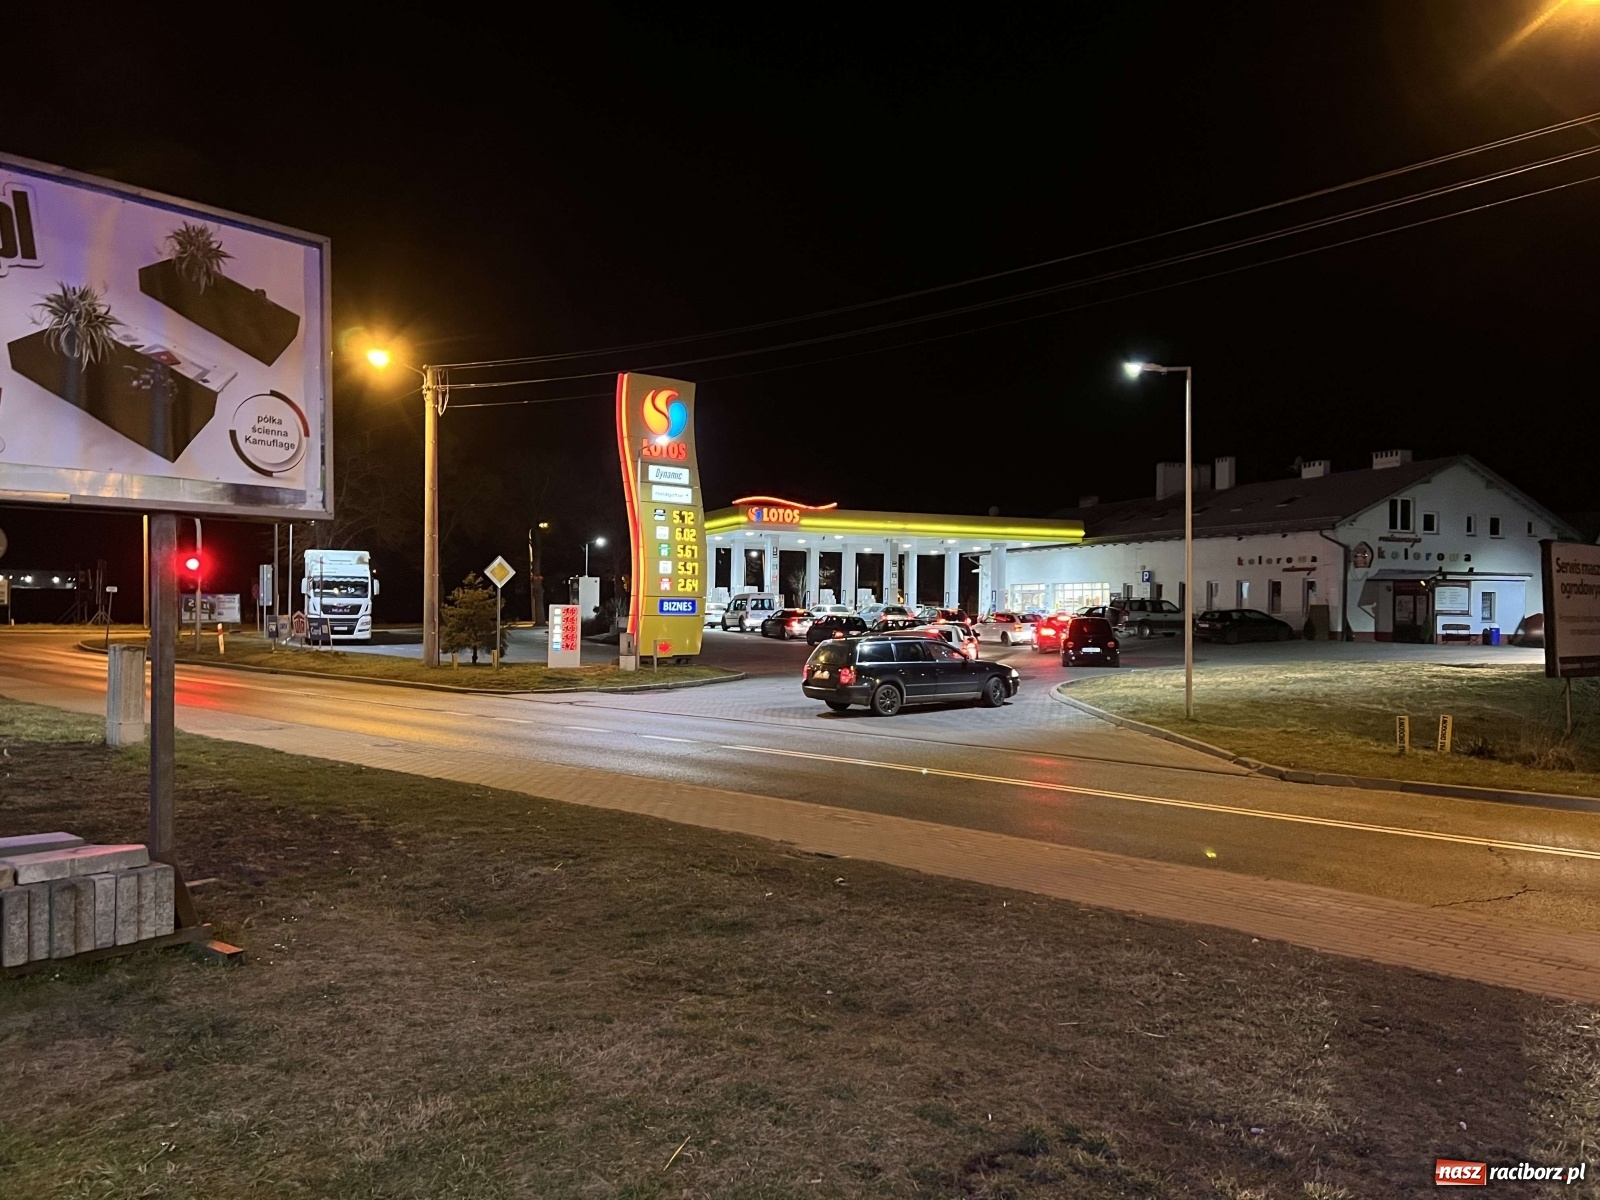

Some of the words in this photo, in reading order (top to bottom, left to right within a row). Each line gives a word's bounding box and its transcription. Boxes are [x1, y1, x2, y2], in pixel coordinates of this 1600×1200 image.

[252, 425, 289, 437] ścienna
[245, 435, 295, 451] Kamuflage
[642, 438, 687, 460] LOTOS
[655, 468, 683, 480] Dynamic
[672, 510, 695, 525] 5.72
[762, 507, 801, 524] LOTOS
[675, 527, 697, 542] 6.02
[676, 544, 698, 558] 5.67
[1378, 546, 1471, 562] kolorowa
[1237, 555, 1318, 566] kolorowa
[1556, 557, 1581, 574] Serwis
[677, 561, 699, 576] 5.97
[1143, 571, 1149, 582] P
[677, 579, 699, 592] 2.64
[1561, 578, 1600, 599] ogrodowy
[663, 601, 693, 611] BIZNES
